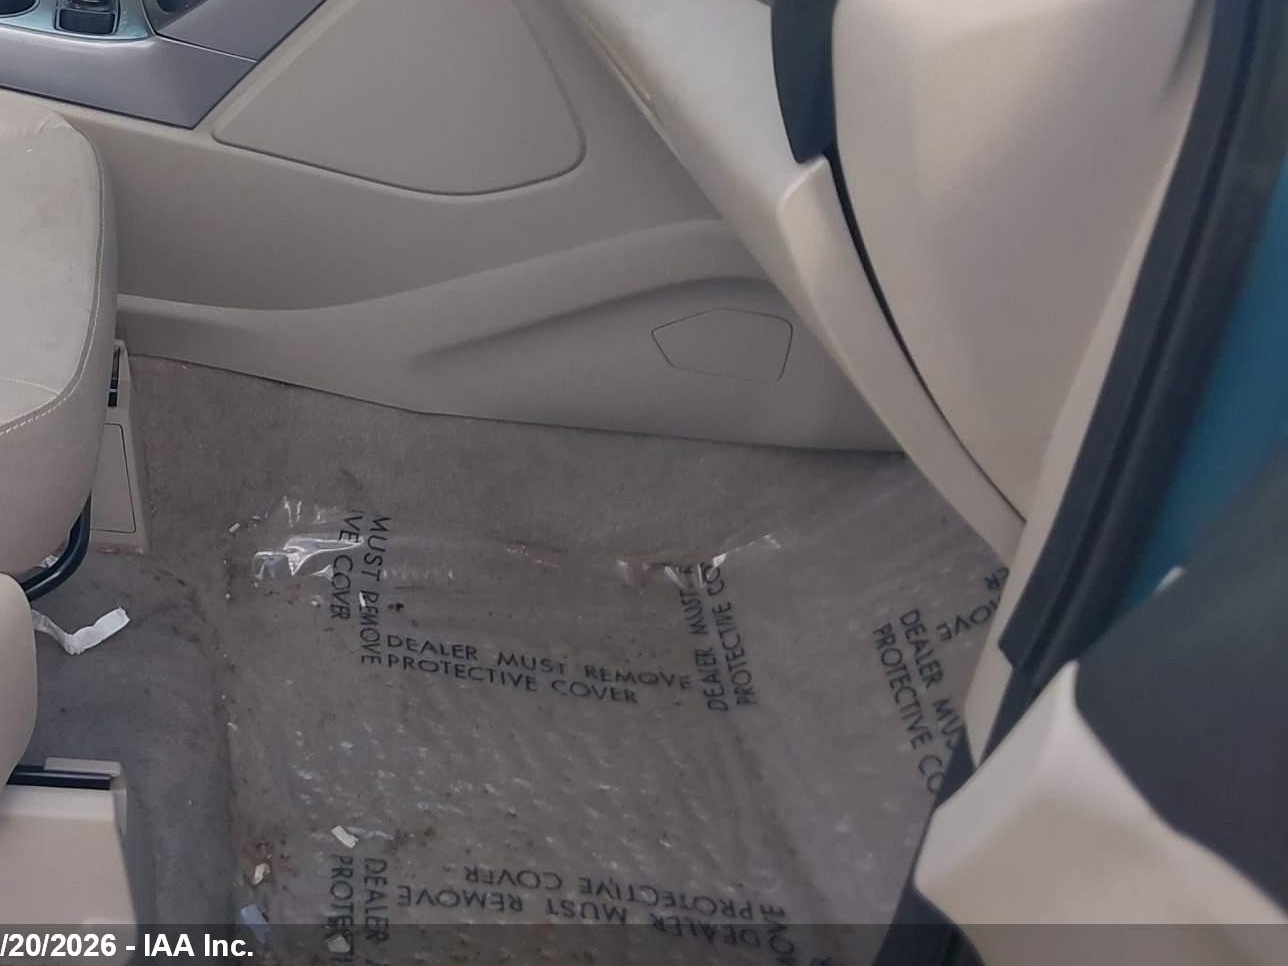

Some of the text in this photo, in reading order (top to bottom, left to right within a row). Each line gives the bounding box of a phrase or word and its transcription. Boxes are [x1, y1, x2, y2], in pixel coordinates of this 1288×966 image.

[361, 516, 393, 582] MUST
[679, 589, 709, 635] MUST
[387, 634, 693, 691] DEALER MUST REMOVE
[712, 601, 759, 706] PROTECTIVE
[899, 608, 945, 689] DEALER
[387, 654, 639, 705] PROTECTIVE COVER
[695, 647, 729, 712] DEALER
[872, 622, 934, 750] PROTECTIVE
[364, 857, 390, 944] DEALER
[396, 885, 524, 913] REMOVE
[464, 866, 754, 920] PROTECTIVE COVER
[545, 897, 627, 925] MUST
